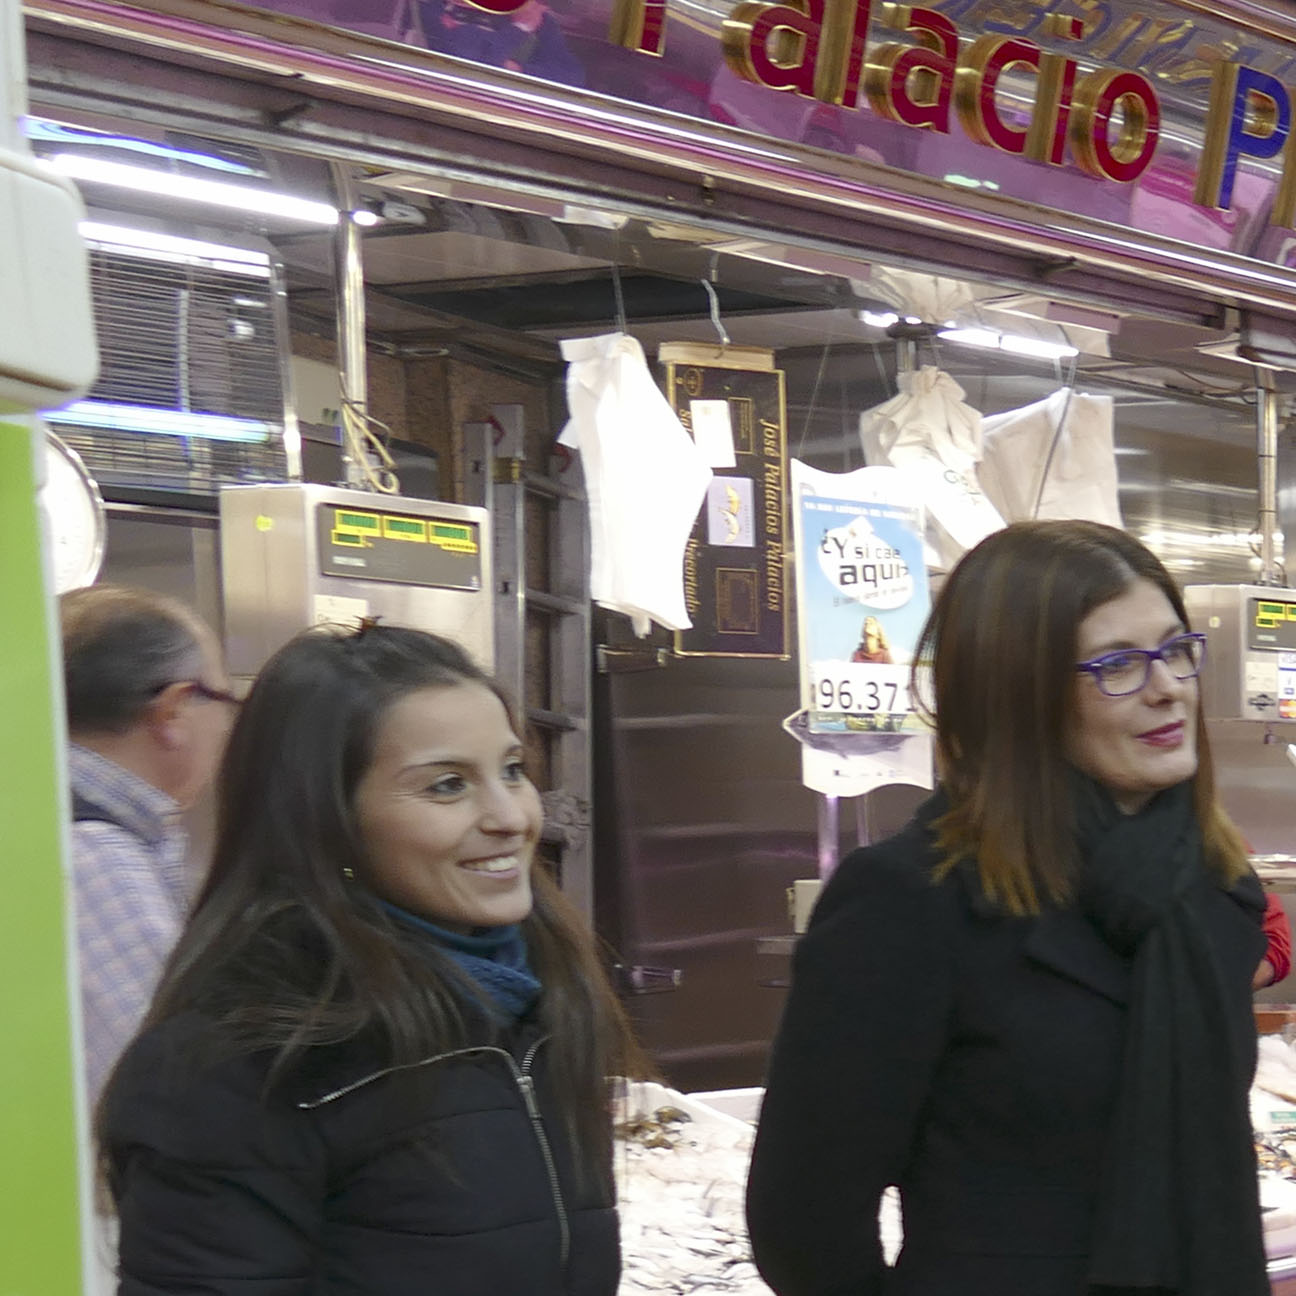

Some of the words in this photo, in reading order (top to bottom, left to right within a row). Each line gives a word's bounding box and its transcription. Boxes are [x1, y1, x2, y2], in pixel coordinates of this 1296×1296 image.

[612, 0, 1161, 184] alacio
[854, 544, 871, 560] si
[875, 547, 901, 560] cae
